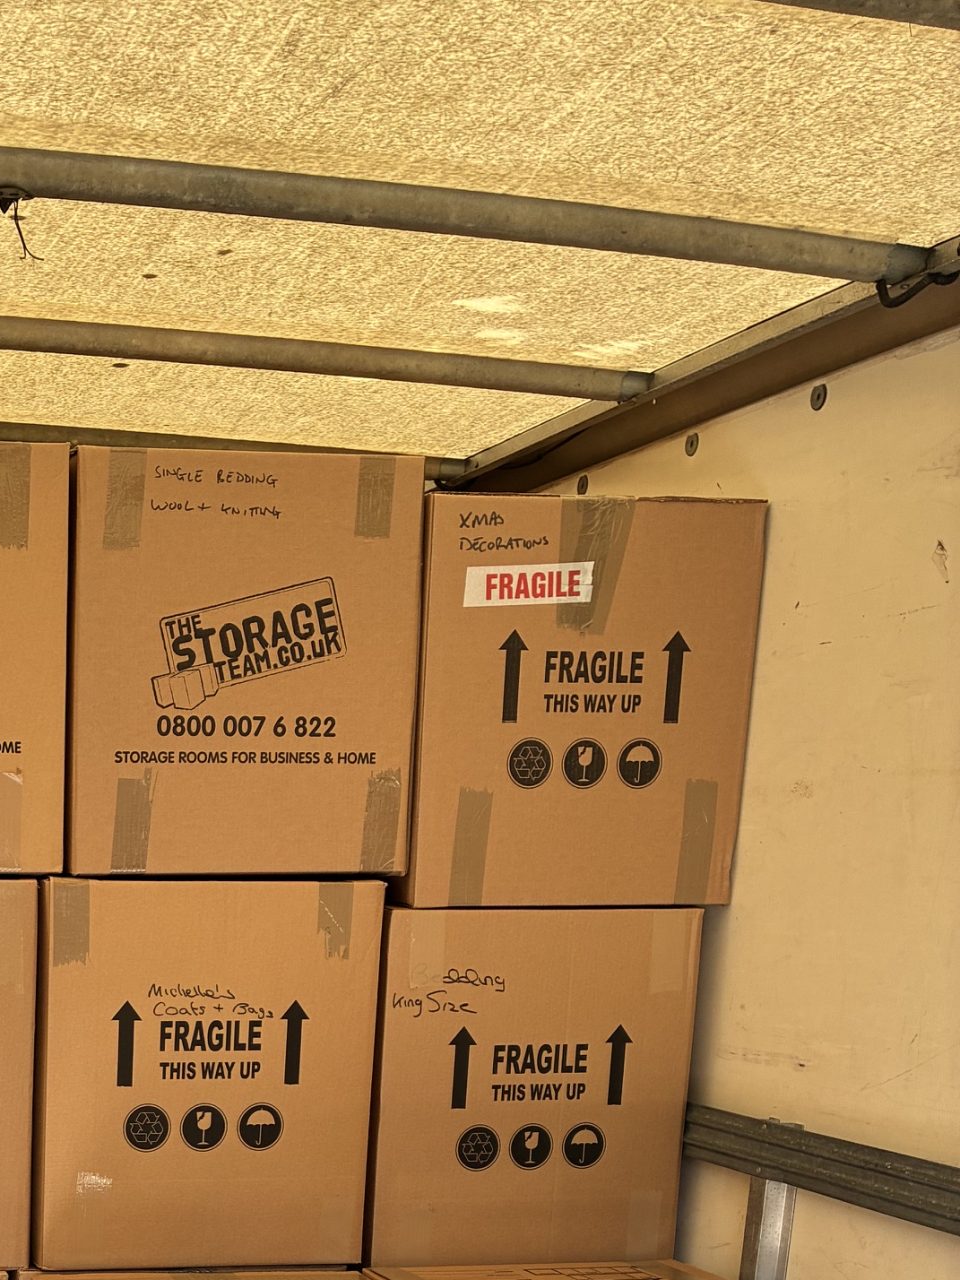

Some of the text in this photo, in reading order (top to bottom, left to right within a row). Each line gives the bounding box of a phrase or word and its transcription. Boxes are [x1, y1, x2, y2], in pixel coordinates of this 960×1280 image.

[154, 466, 279, 488] SINGLE BEDDING
[151, 499, 194, 512] WOOL
[459, 512, 504, 528] XMAS
[459, 536, 549, 552] DECORATIONS
[485, 569, 581, 600] FRAGILE
[165, 614, 202, 640] THE
[172, 598, 338, 671] STORAGE
[215, 632, 341, 683] TEAM.CO.UK
[544, 651, 644, 684] FRAGILE
[544, 694, 642, 713] THIS WAY UP
[157, 715, 336, 737] 0800 007 6 822
[153, 1002, 206, 1016] Coats
[159, 1020, 262, 1052] FRAGILE
[492, 1043, 589, 1074] FRAGILE
[160, 1061, 261, 1079] THIS WAY UP
[492, 1083, 586, 1101] THIS WAY UP
